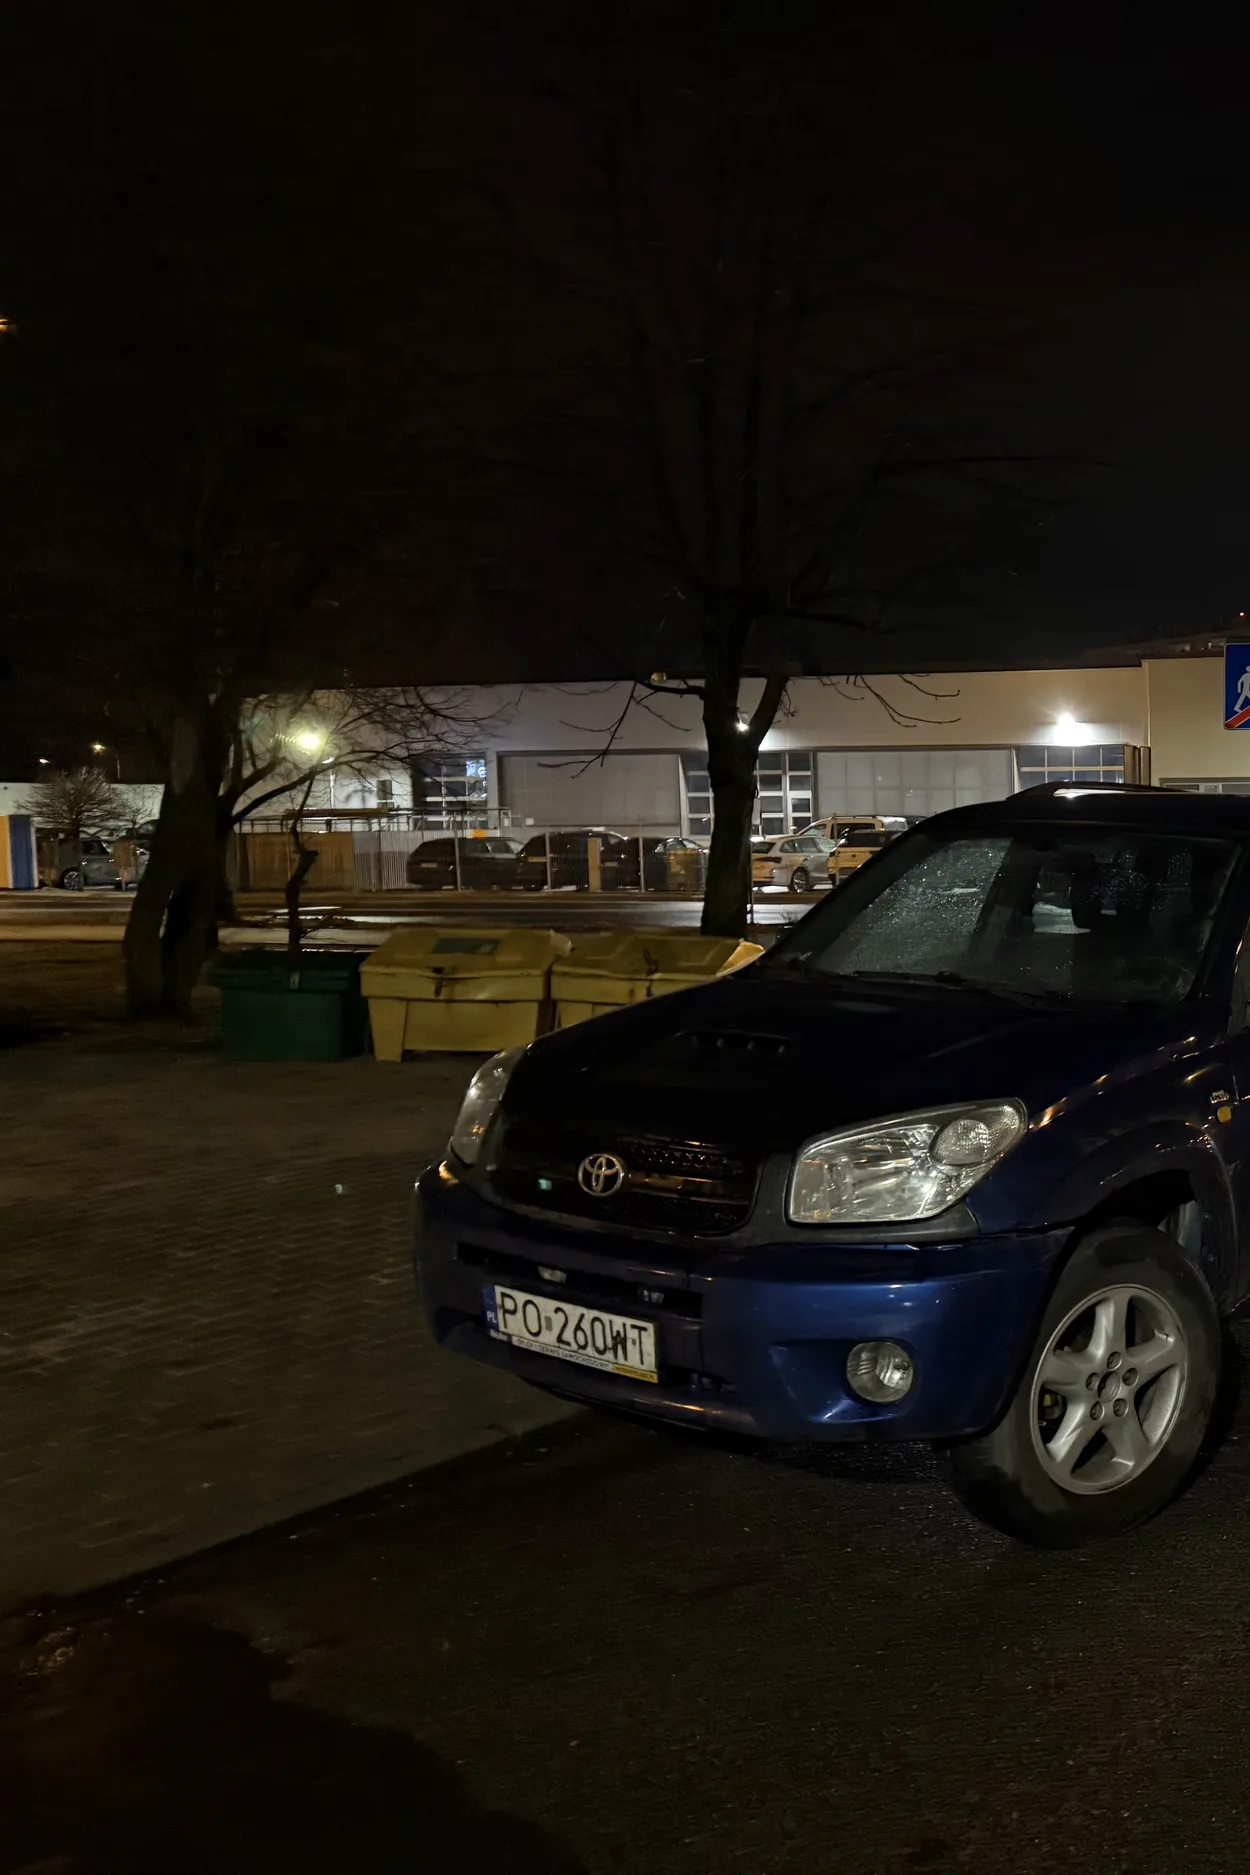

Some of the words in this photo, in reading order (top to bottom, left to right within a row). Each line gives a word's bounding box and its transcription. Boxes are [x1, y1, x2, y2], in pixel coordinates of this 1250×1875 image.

[486, 1310, 497, 1323] PL
[500, 1291, 542, 1338] PO
[554, 1307, 648, 1366] 260WT
